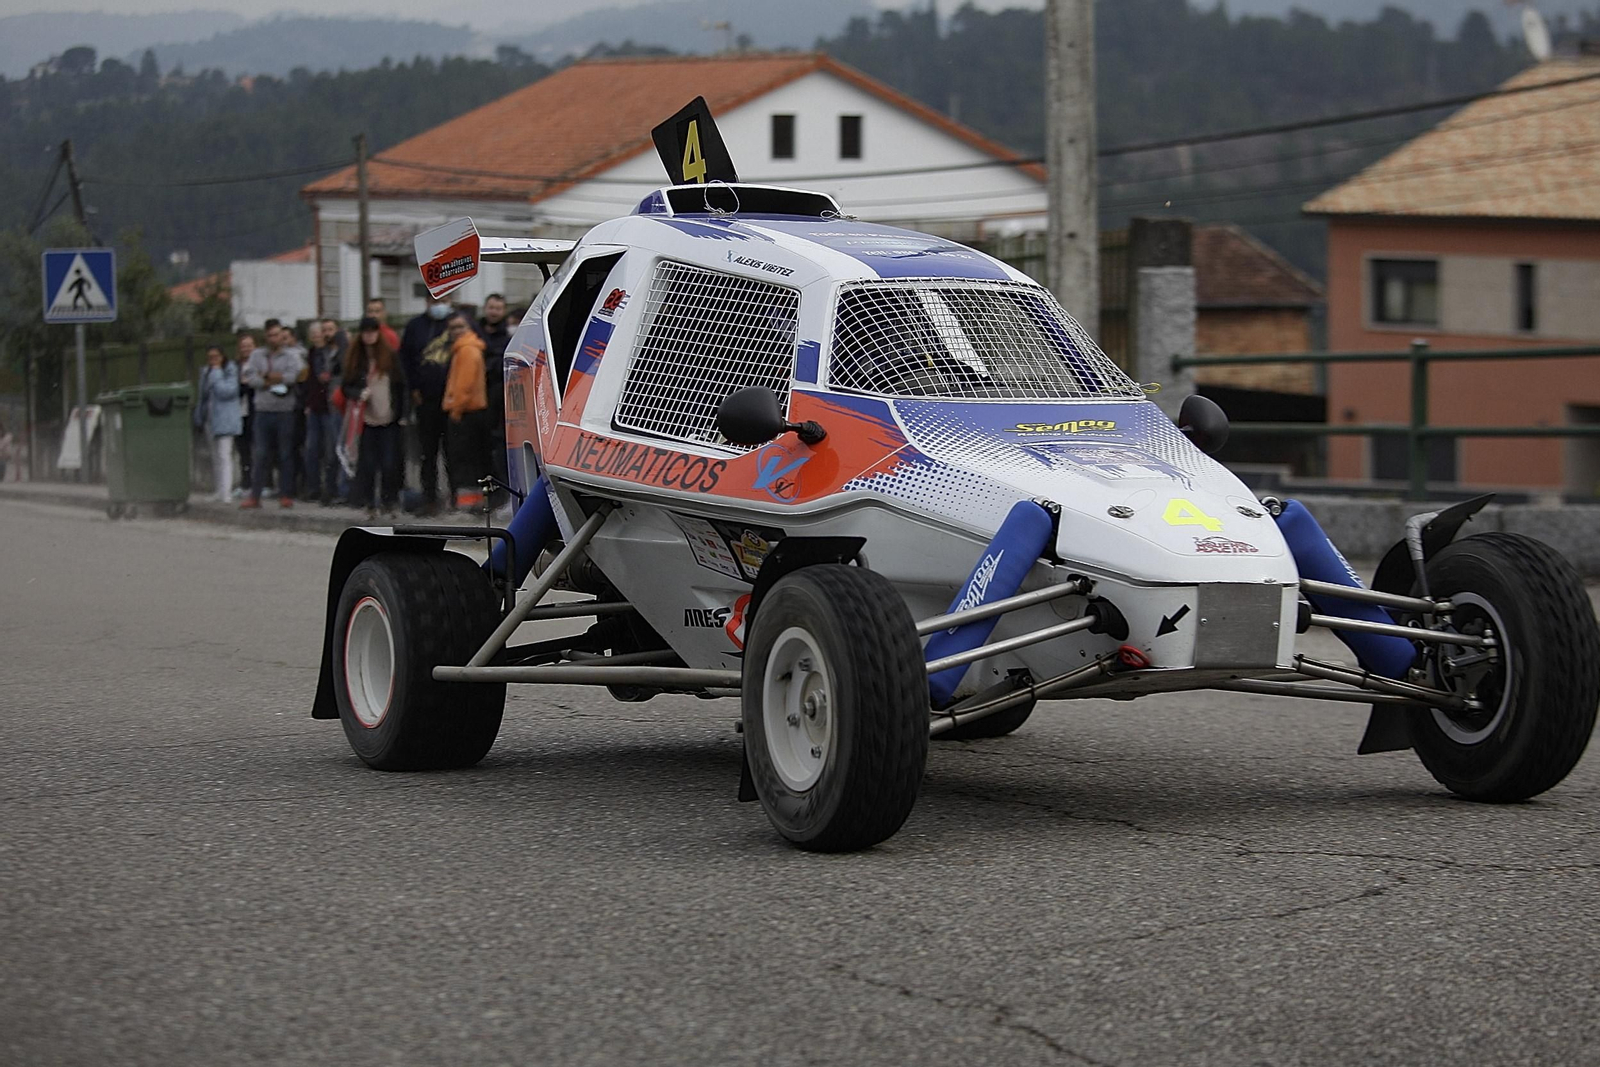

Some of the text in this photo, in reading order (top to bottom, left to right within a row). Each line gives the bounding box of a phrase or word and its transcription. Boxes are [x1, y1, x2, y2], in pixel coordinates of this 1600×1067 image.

[682, 119, 707, 184] 4
[733, 256, 795, 277] ALEXIS VIEITEZ
[566, 432, 728, 493] NEUMATICOS
[1161, 498, 1225, 532] 4
